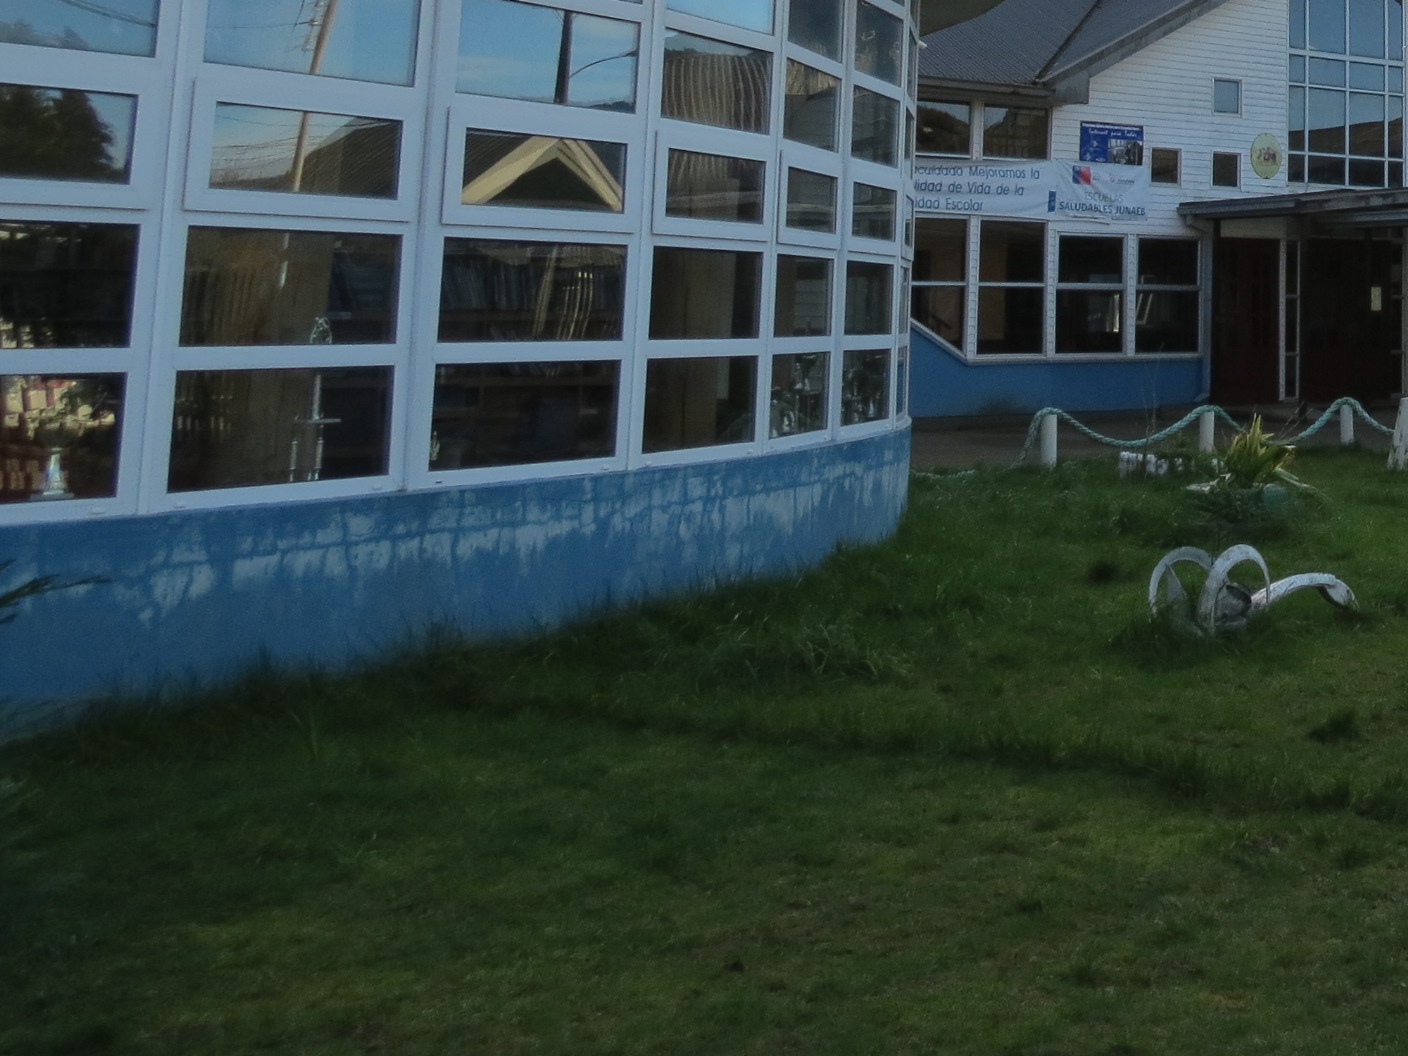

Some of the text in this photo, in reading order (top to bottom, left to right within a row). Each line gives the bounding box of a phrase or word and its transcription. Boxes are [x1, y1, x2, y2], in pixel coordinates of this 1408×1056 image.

[969, 165, 1026, 179] Mejoramos
[1031, 168, 1040, 180] la
[948, 181, 963, 193] de
[967, 181, 991, 195] Vida
[996, 182, 1010, 196] de
[1015, 184, 1025, 196] la
[945, 197, 984, 212] Escolar
[1085, 191, 1124, 203] ESCUELAS
[1059, 201, 1146, 216] SALUDABLES JUNAEB
